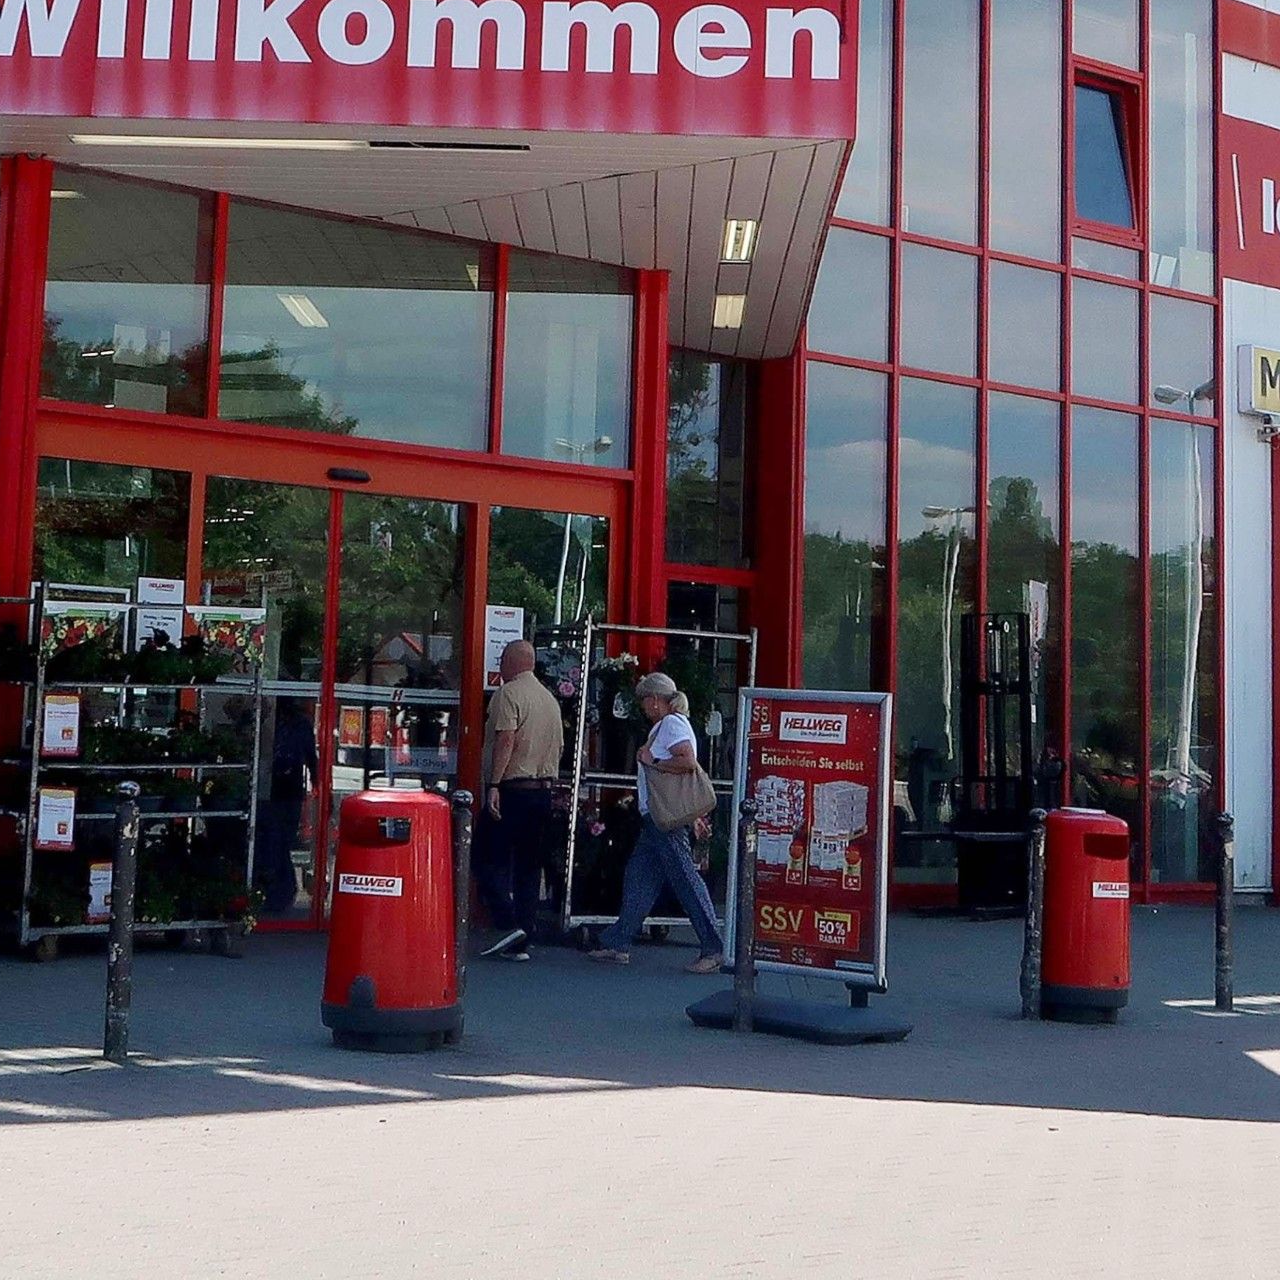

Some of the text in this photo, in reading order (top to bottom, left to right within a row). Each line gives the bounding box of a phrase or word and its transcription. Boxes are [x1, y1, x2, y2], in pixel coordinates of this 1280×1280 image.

[784, 717, 842, 732] HELLWEG
[761, 753, 864, 772] Entscheiden Sie selbst
[341, 875, 396, 889] HELLWEG
[760, 904, 803, 932] SSV
[818, 934, 847, 945] RABATT
